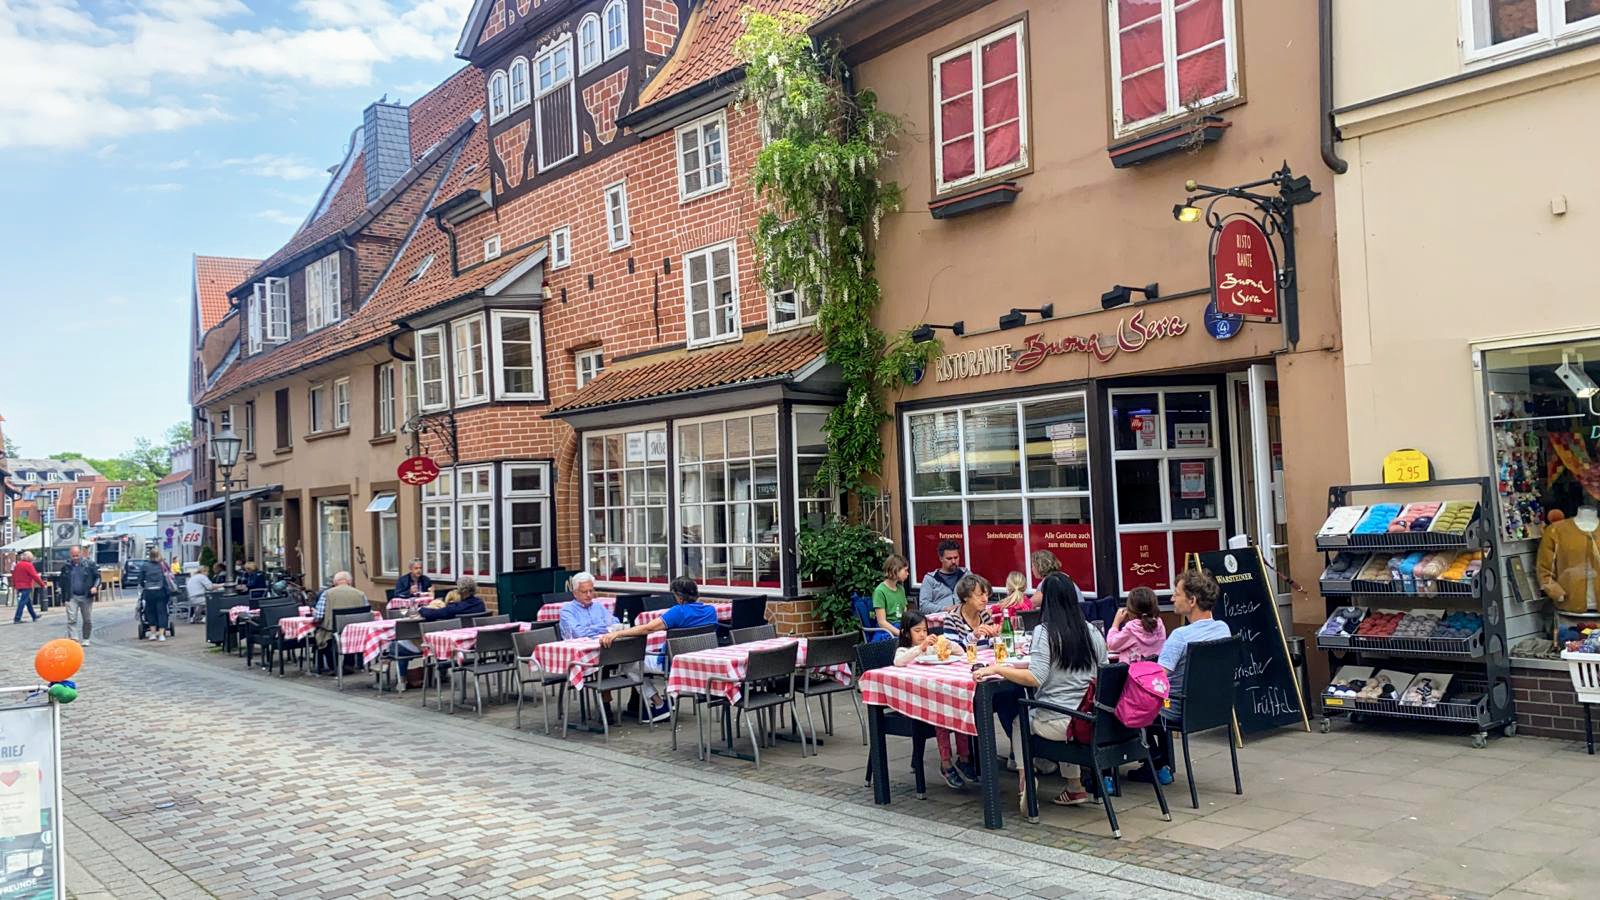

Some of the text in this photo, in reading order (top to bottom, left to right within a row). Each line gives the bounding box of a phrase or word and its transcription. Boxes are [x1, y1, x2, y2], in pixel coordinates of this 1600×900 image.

[1236, 234, 1252, 250] RISTO
[1220, 273, 1272, 294] Buona
[1231, 289, 1262, 306] Sera
[936, 309, 1189, 382] RISTORANTE Buona Sera
[1395, 465, 1421, 481] 2.95
[1044, 531, 1091, 540] Alle Gerichte auch
[1215, 573, 1253, 584] WARSTEINER
[1223, 592, 1261, 618] Pasta
